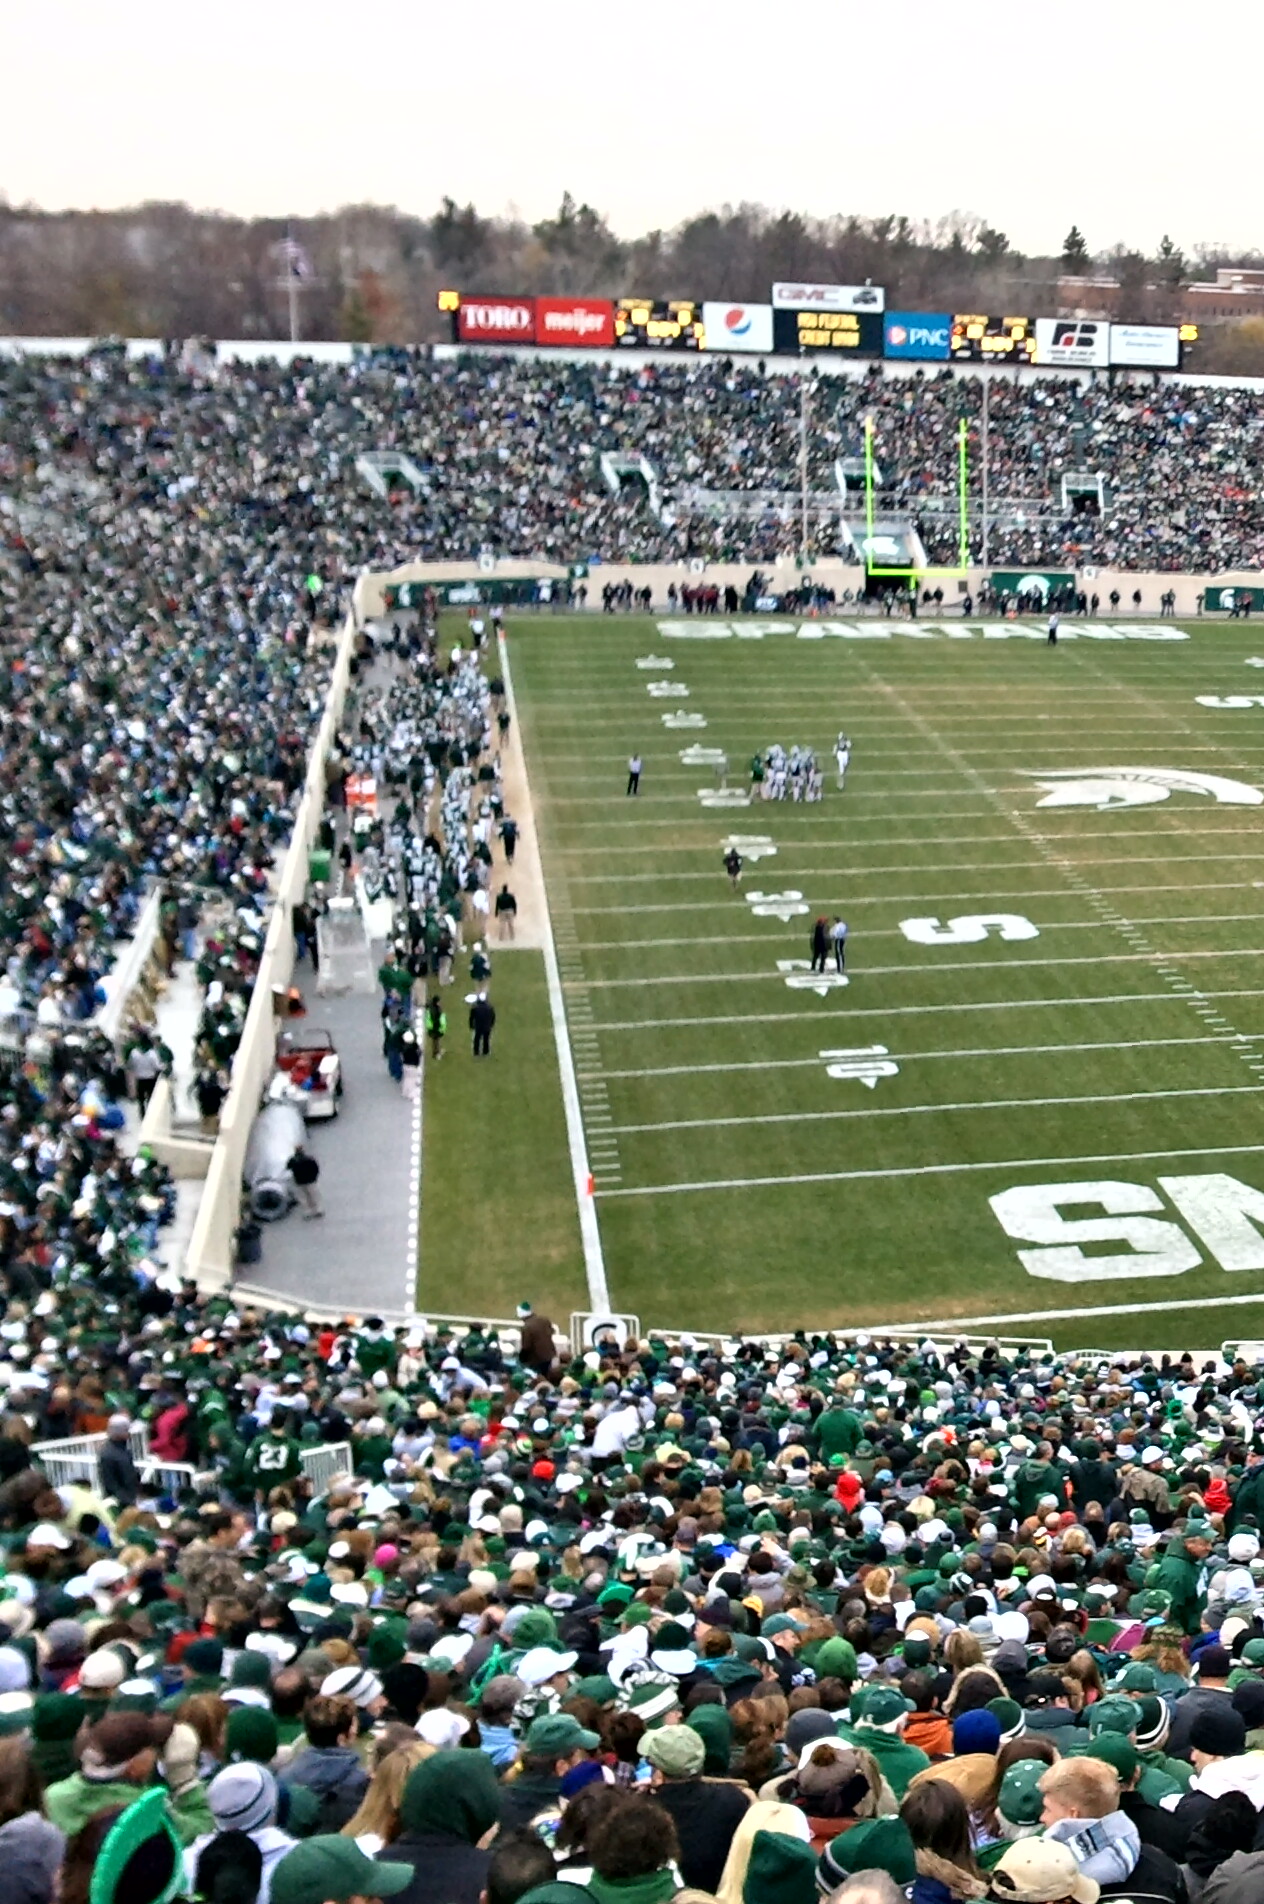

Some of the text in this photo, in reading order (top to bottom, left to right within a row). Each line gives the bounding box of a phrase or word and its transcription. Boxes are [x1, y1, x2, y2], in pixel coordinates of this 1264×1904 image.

[461, 304, 530, 329] TORO
[545, 308, 605, 335] meijer
[909, 328, 948, 346] PNC
[818, 1045, 900, 1080] 10
[259, 1443, 289, 1470] 23
